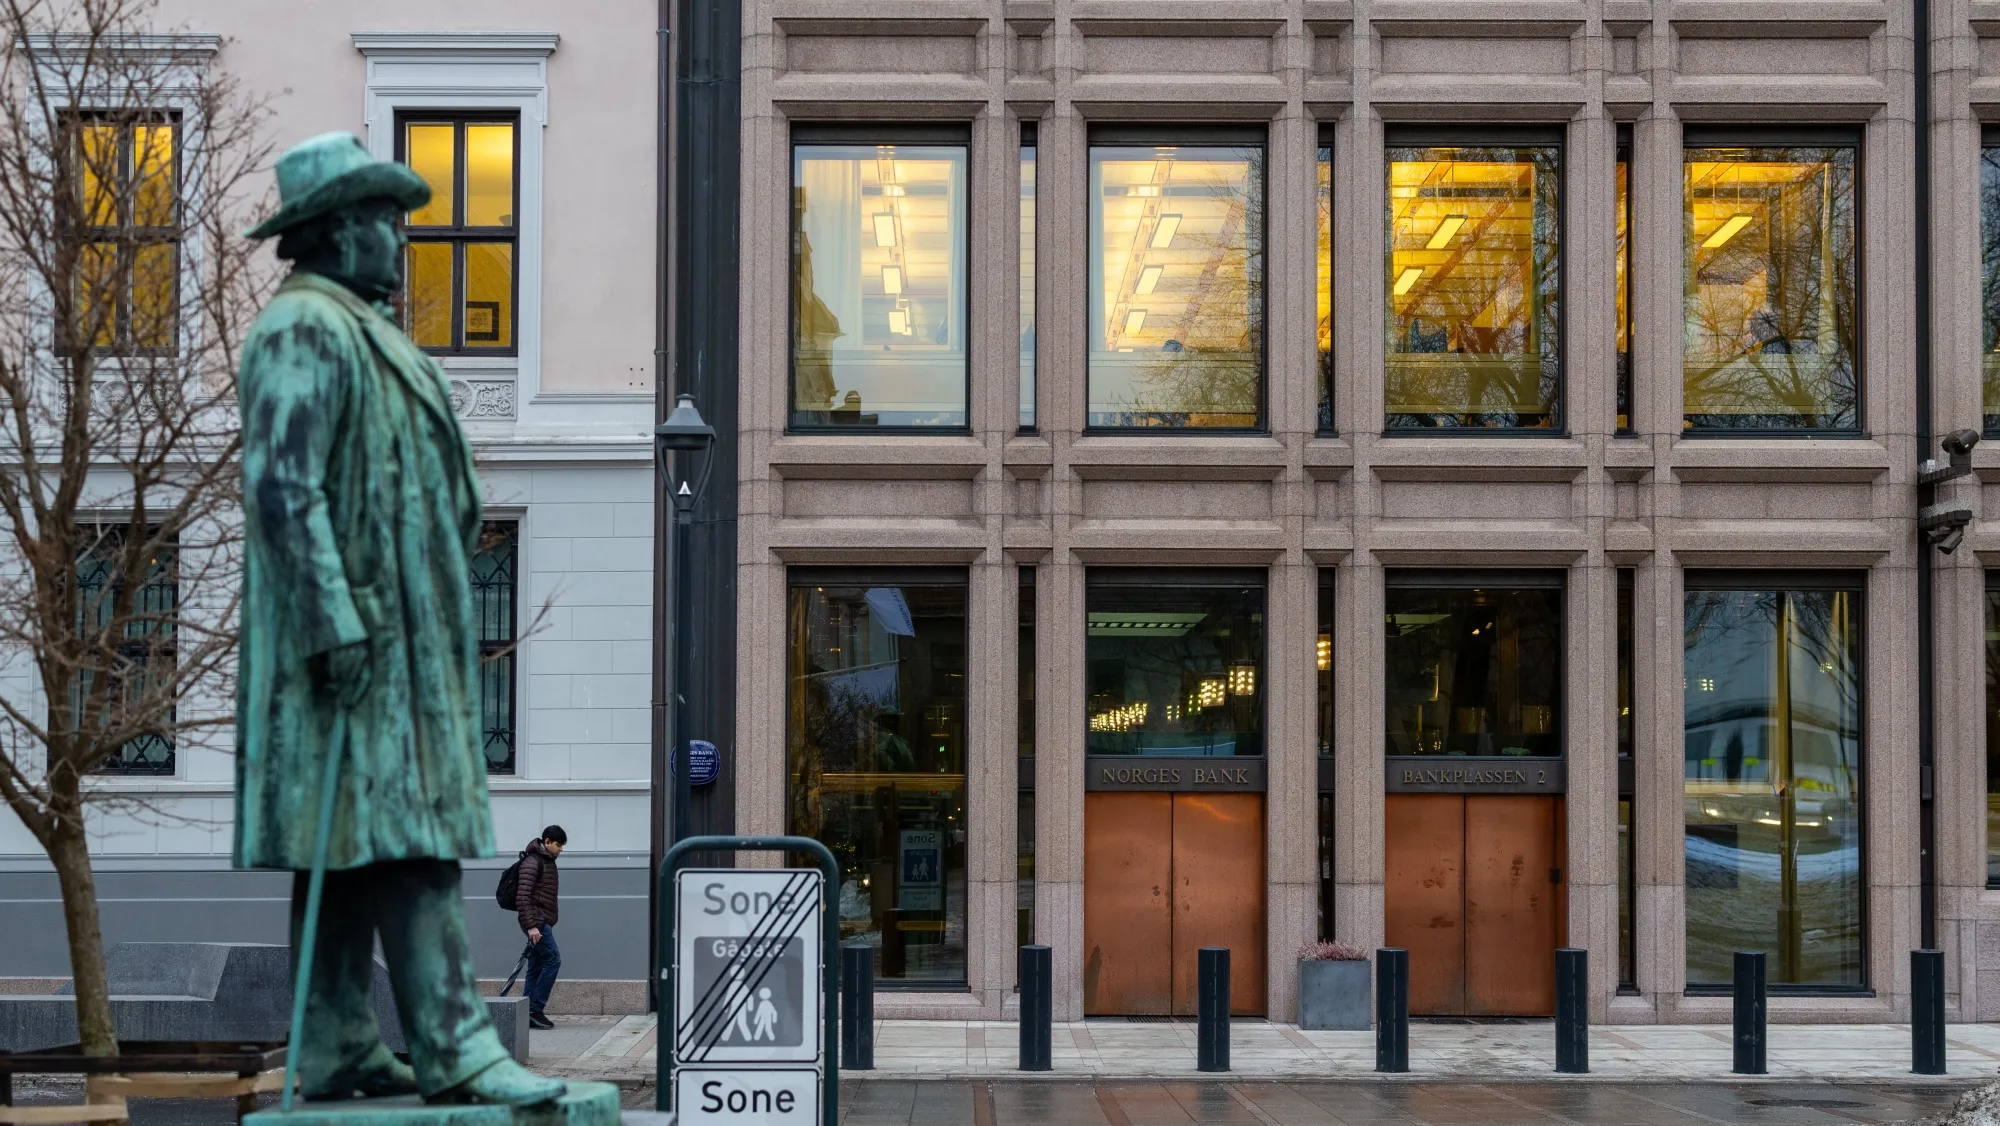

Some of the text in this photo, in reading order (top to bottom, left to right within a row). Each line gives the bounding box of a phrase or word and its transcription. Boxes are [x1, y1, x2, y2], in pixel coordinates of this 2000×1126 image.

[1102, 768, 1249, 783] NORGES BANK
[1403, 770, 1546, 784] BANKPLASSEN 2
[703, 882, 796, 915] Sone
[701, 1080, 796, 1114] Sone
